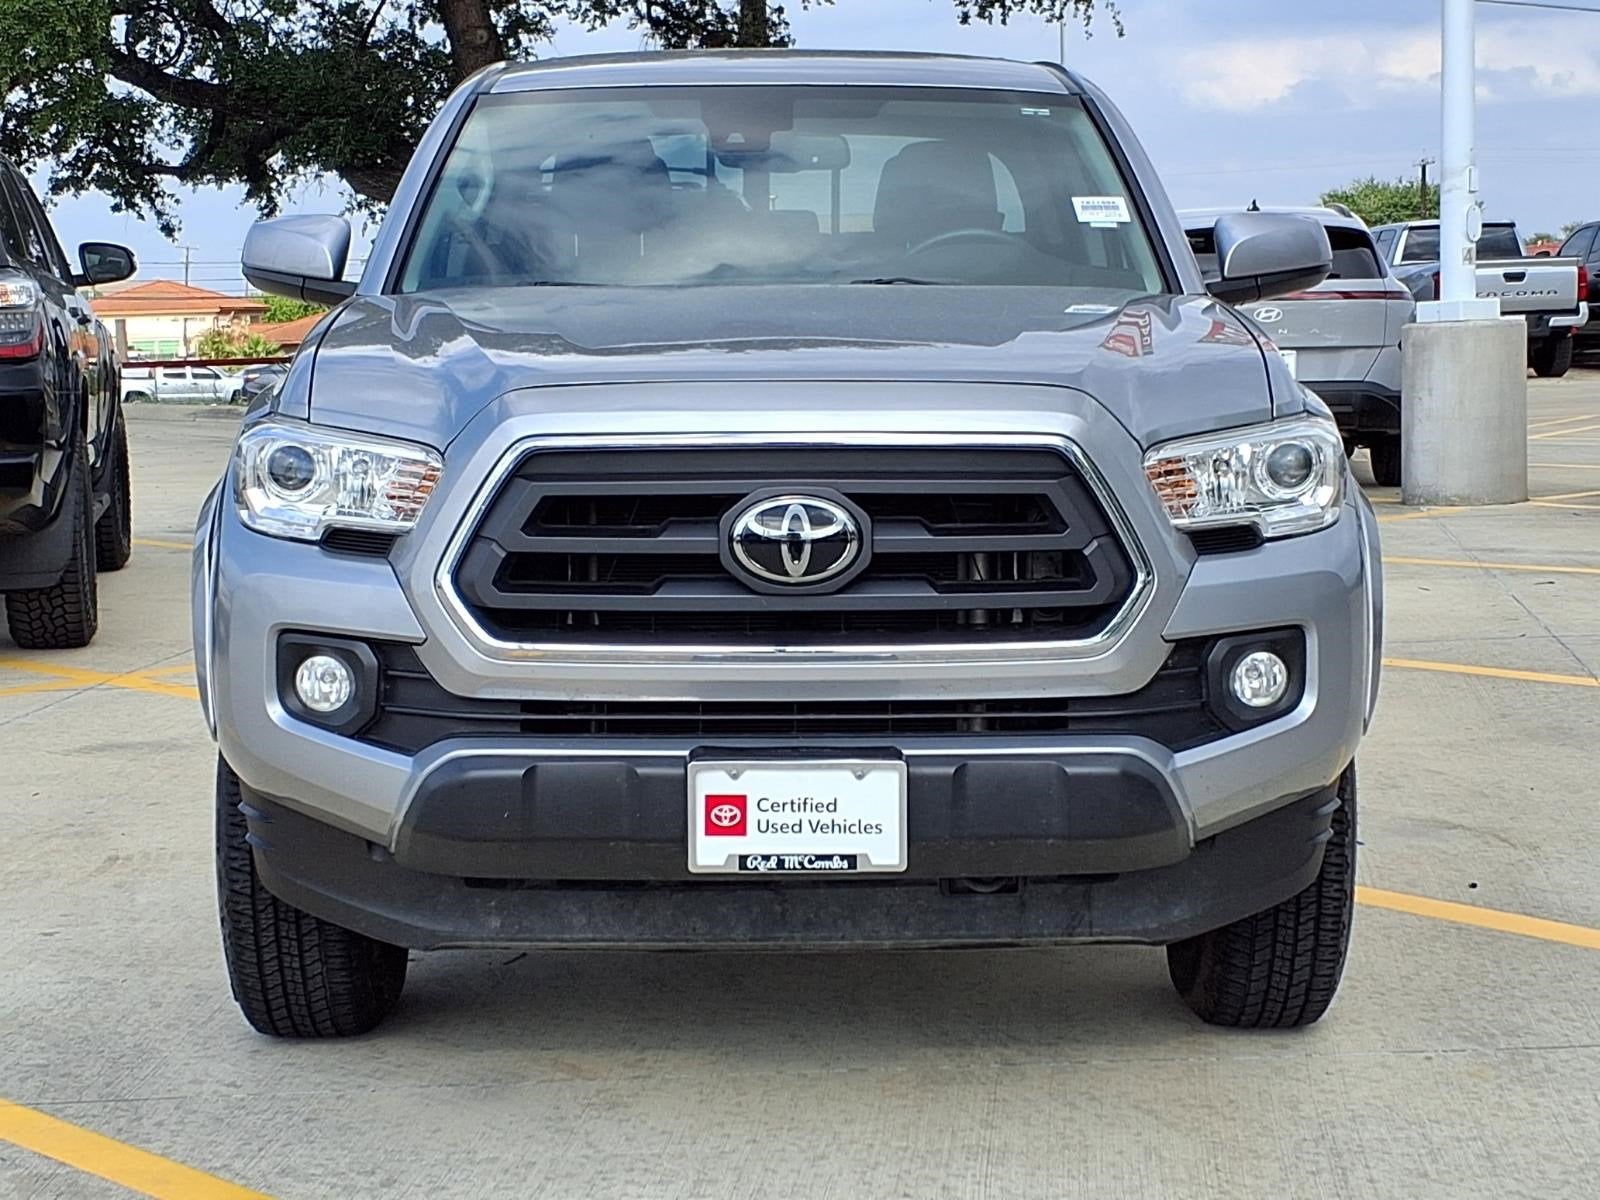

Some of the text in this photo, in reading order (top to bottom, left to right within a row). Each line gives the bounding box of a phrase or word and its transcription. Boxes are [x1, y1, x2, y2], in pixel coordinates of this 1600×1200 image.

[756, 797, 838, 813] Certified
[757, 818, 883, 835] Used Vehicles
[746, 854, 849, 872] Red McCombs
